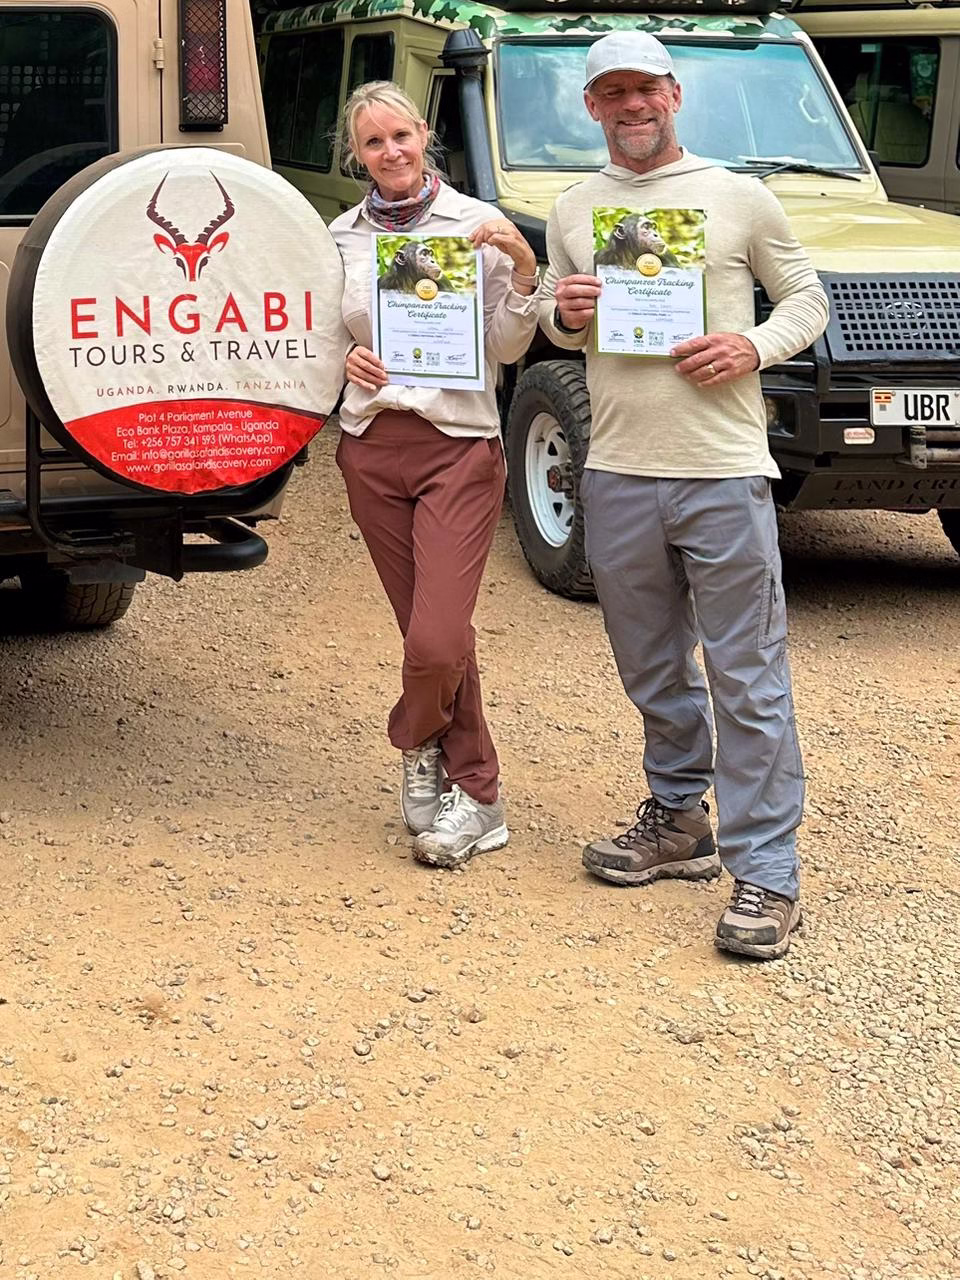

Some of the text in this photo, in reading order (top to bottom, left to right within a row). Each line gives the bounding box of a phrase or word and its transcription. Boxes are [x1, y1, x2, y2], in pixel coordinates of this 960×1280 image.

[605, 276, 695, 289] Chimpanzee Tracking
[627, 286, 672, 297] Certificate
[387, 300, 468, 312] Chimpanzee Tracking
[70, 291, 313, 339] ENGABI
[407, 310, 447, 320] Certificate
[69, 338, 317, 367] TOURS & TRAVEL
[235, 380, 306, 391] TANZANIA
[904, 393, 951, 421] UBR
[138, 409, 253, 422] Plot 4 Parliament Avenue
[116, 427, 135, 437] Eco
[137, 425, 160, 435] Bank
[193, 422, 233, 434] Kampala
[241, 420, 279, 432] Uganda
[123, 432, 273, 449] Tel: +256 757 341 593 (WhatsApp)
[111, 443, 286, 462] Email: info@gorillasafaridiscovery.com
[126, 457, 272, 474] www.gorillasafaridiscovery.com
[833, 479, 904, 491] LAND
